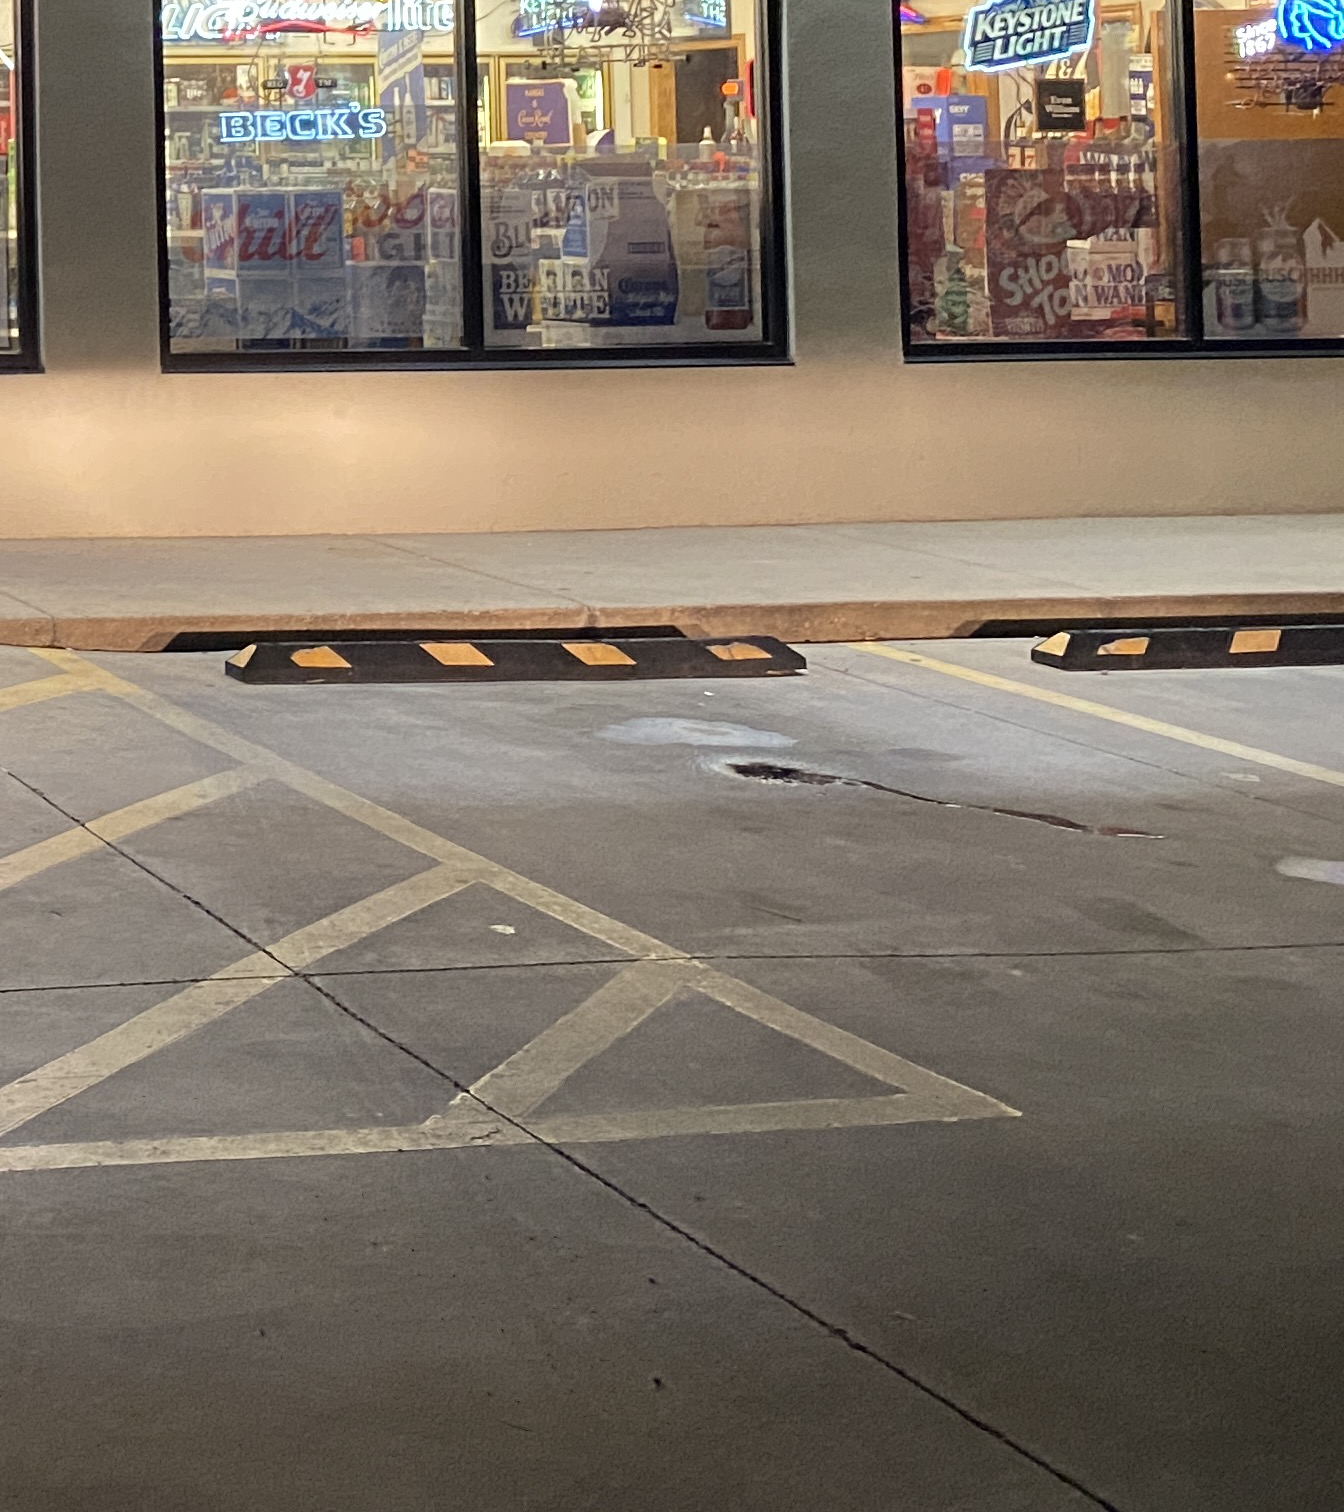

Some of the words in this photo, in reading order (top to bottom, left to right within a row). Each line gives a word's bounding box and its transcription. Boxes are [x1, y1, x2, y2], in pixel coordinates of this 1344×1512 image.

[993, 26, 1068, 60] LIGHT
[1238, 33, 1276, 58] 1867
[219, 101, 387, 143] BECK'S
[998, 254, 1069, 306] SHO
[1030, 288, 1073, 325] TO
